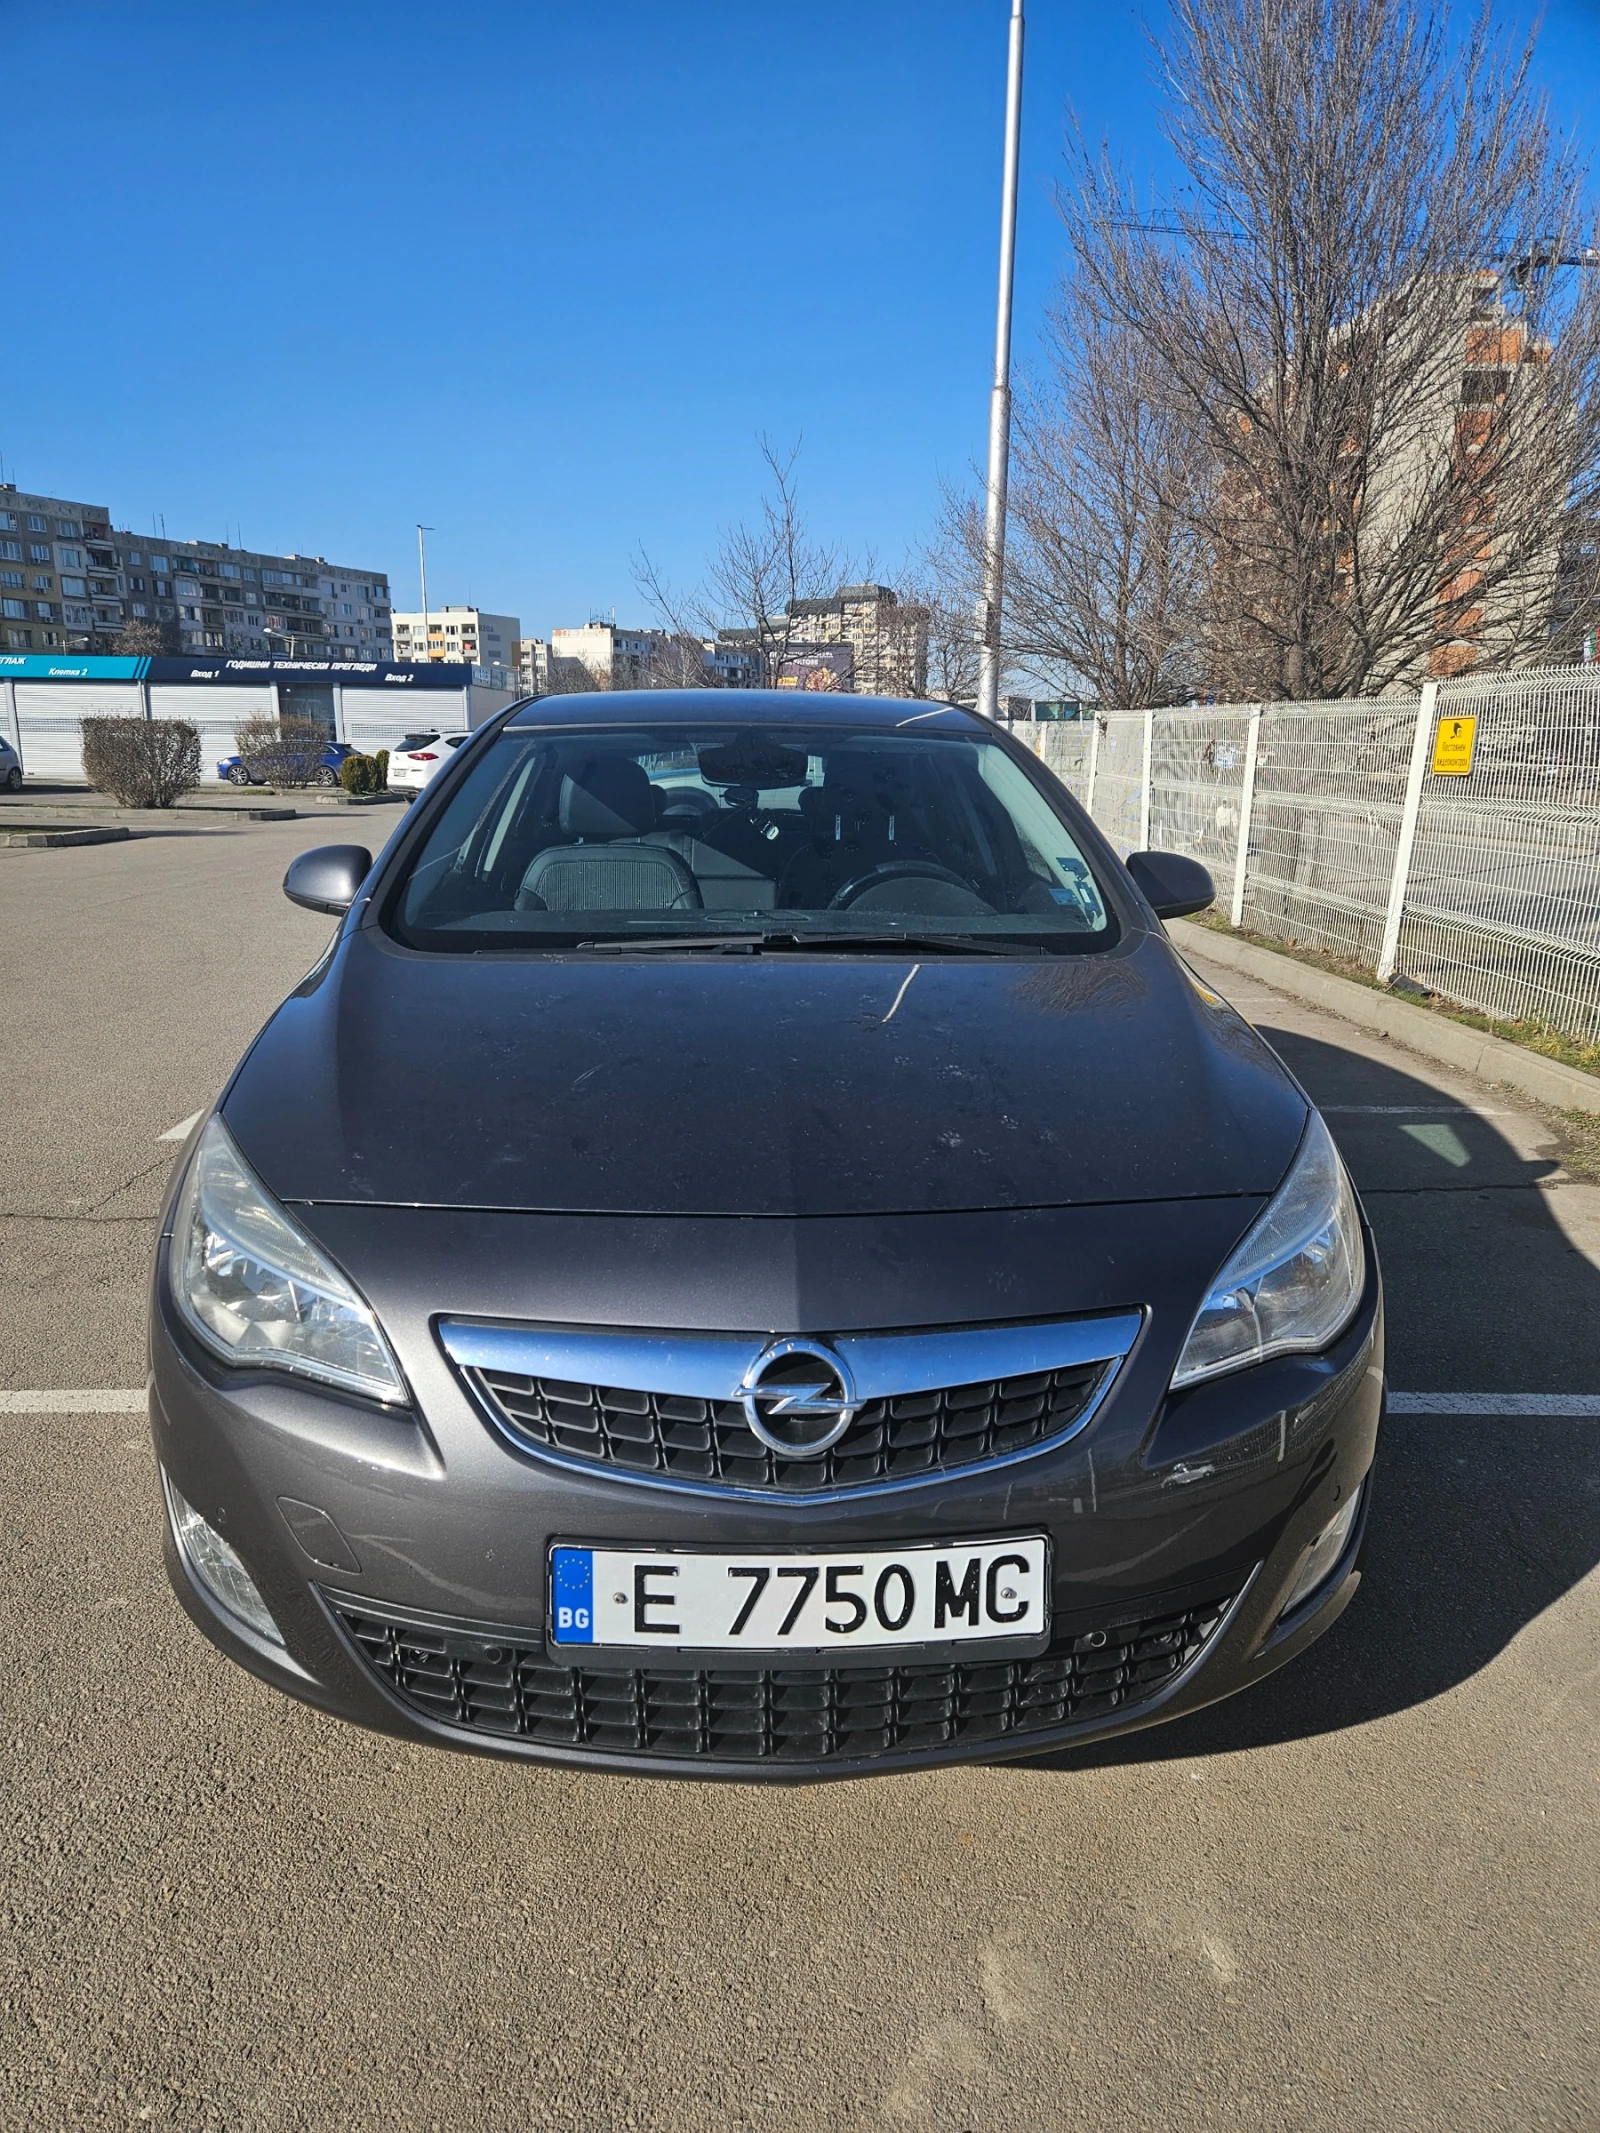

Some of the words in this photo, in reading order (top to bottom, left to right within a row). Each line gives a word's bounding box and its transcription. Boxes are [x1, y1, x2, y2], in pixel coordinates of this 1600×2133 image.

[48, 667, 80, 676] Клетка
[81, 668, 88, 676] 2
[225, 660, 271, 669] ГОДИШНИ
[273, 661, 330, 670] ТЕХНИЧЕСКИ
[331, 662, 378, 672] ПРЕГЛЕДИ
[190, 669, 213, 678] Вход
[385, 673, 407, 683] Вход
[407, 674, 414, 682] 2
[634, 1565, 680, 1635] E
[728, 1564, 915, 1637] 7750
[934, 1555, 1031, 1630] MC
[558, 1606, 590, 1629] BG
